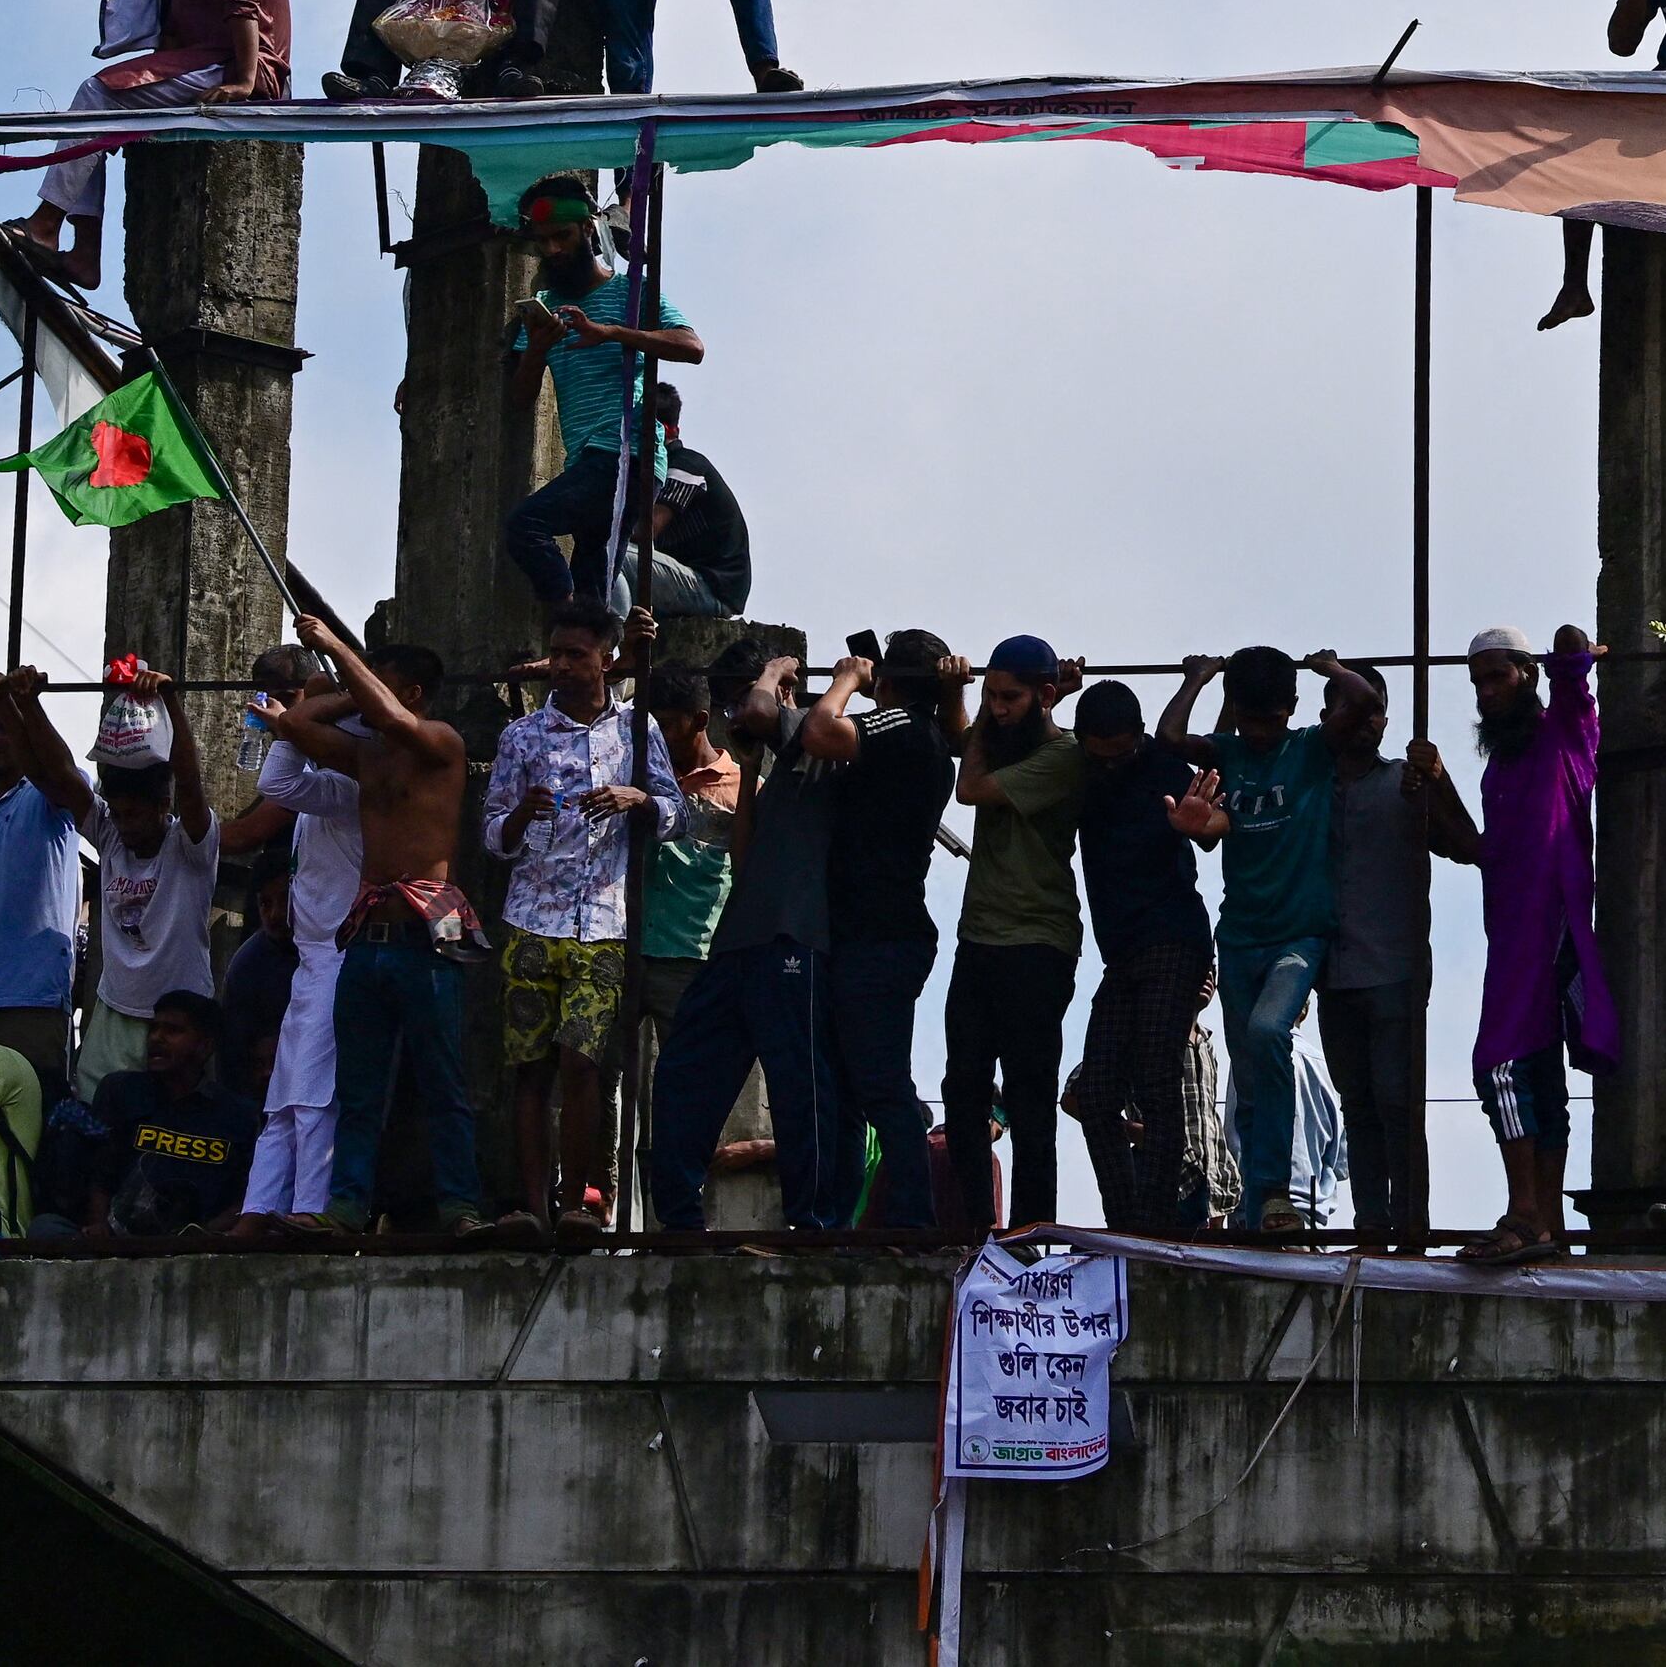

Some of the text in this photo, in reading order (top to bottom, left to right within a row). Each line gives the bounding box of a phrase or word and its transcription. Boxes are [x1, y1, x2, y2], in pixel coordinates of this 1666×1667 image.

[137, 1128, 225, 1162] PRESS
[970, 1299, 1112, 1338] শিক্ষার্থীর উপর
[998, 1343, 1088, 1381] গুলি কেন
[993, 1387, 1091, 1427] জবাব চাই
[993, 1445, 1043, 1461] জাগ্রত
[1045, 1438, 1107, 1461] বাংলাদেশ
